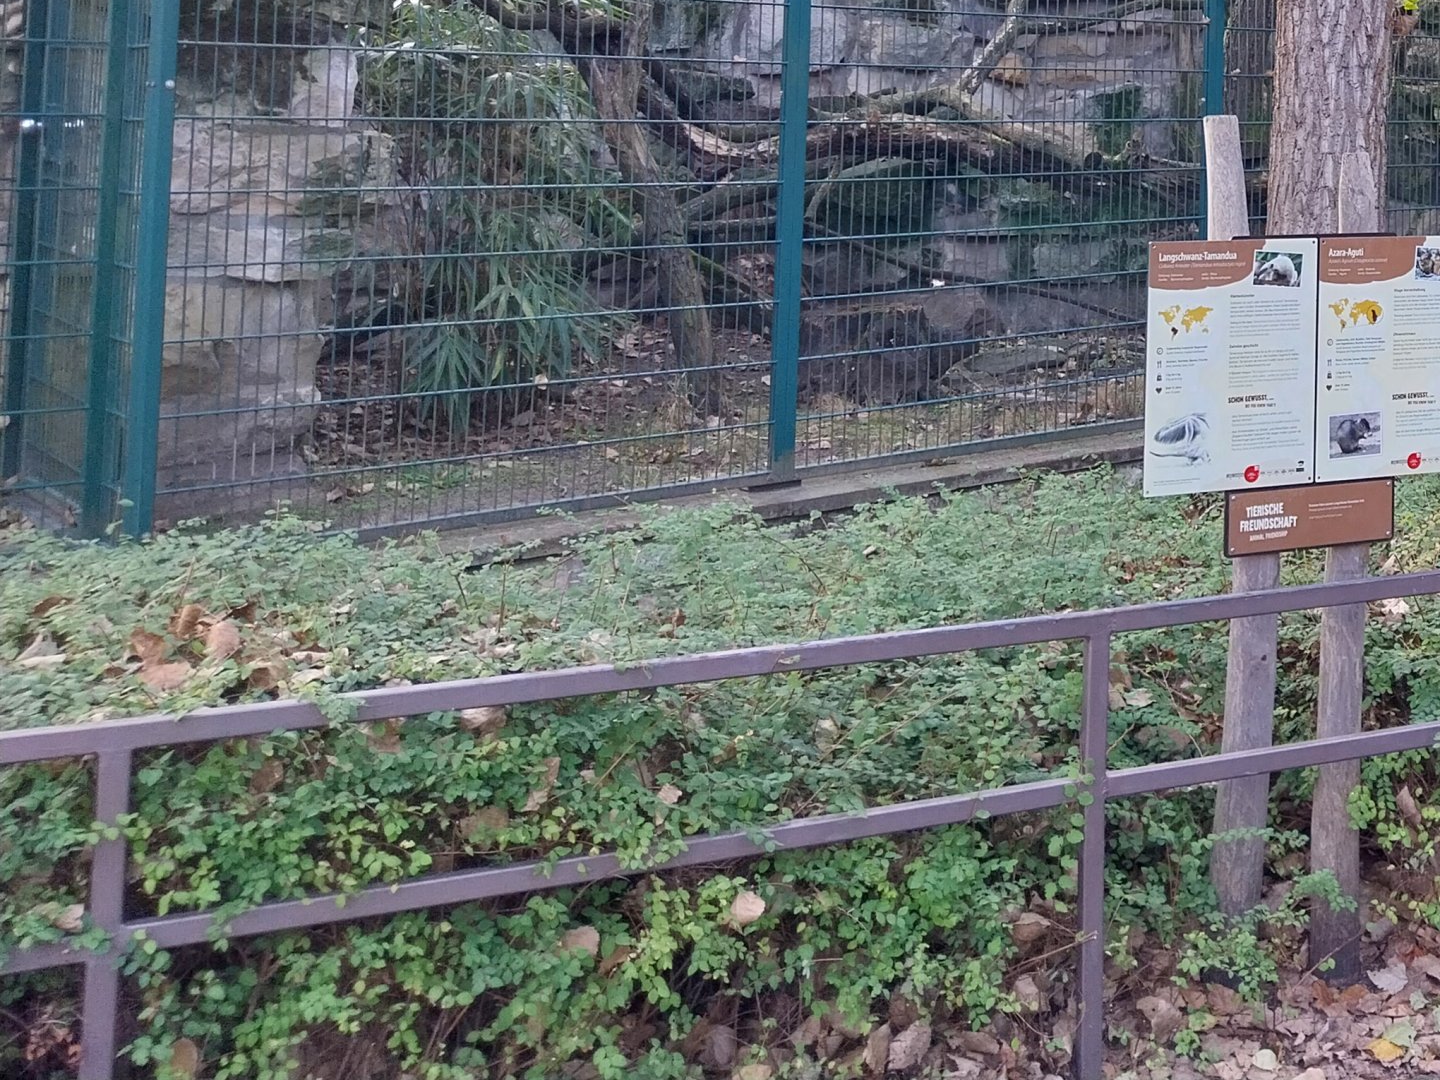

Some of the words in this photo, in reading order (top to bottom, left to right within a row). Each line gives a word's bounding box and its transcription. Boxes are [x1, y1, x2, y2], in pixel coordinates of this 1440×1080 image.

[1158, 251, 1238, 263] Langschwanz-Tamandua
[1328, 248, 1364, 259] Azara-Aguti
[1228, 396, 1244, 404] SCHON
[1392, 393, 1406, 401] SCHON
[1245, 502, 1284, 518] TIERISCHE
[1239, 515, 1298, 533] FREUNDSCHAFT
